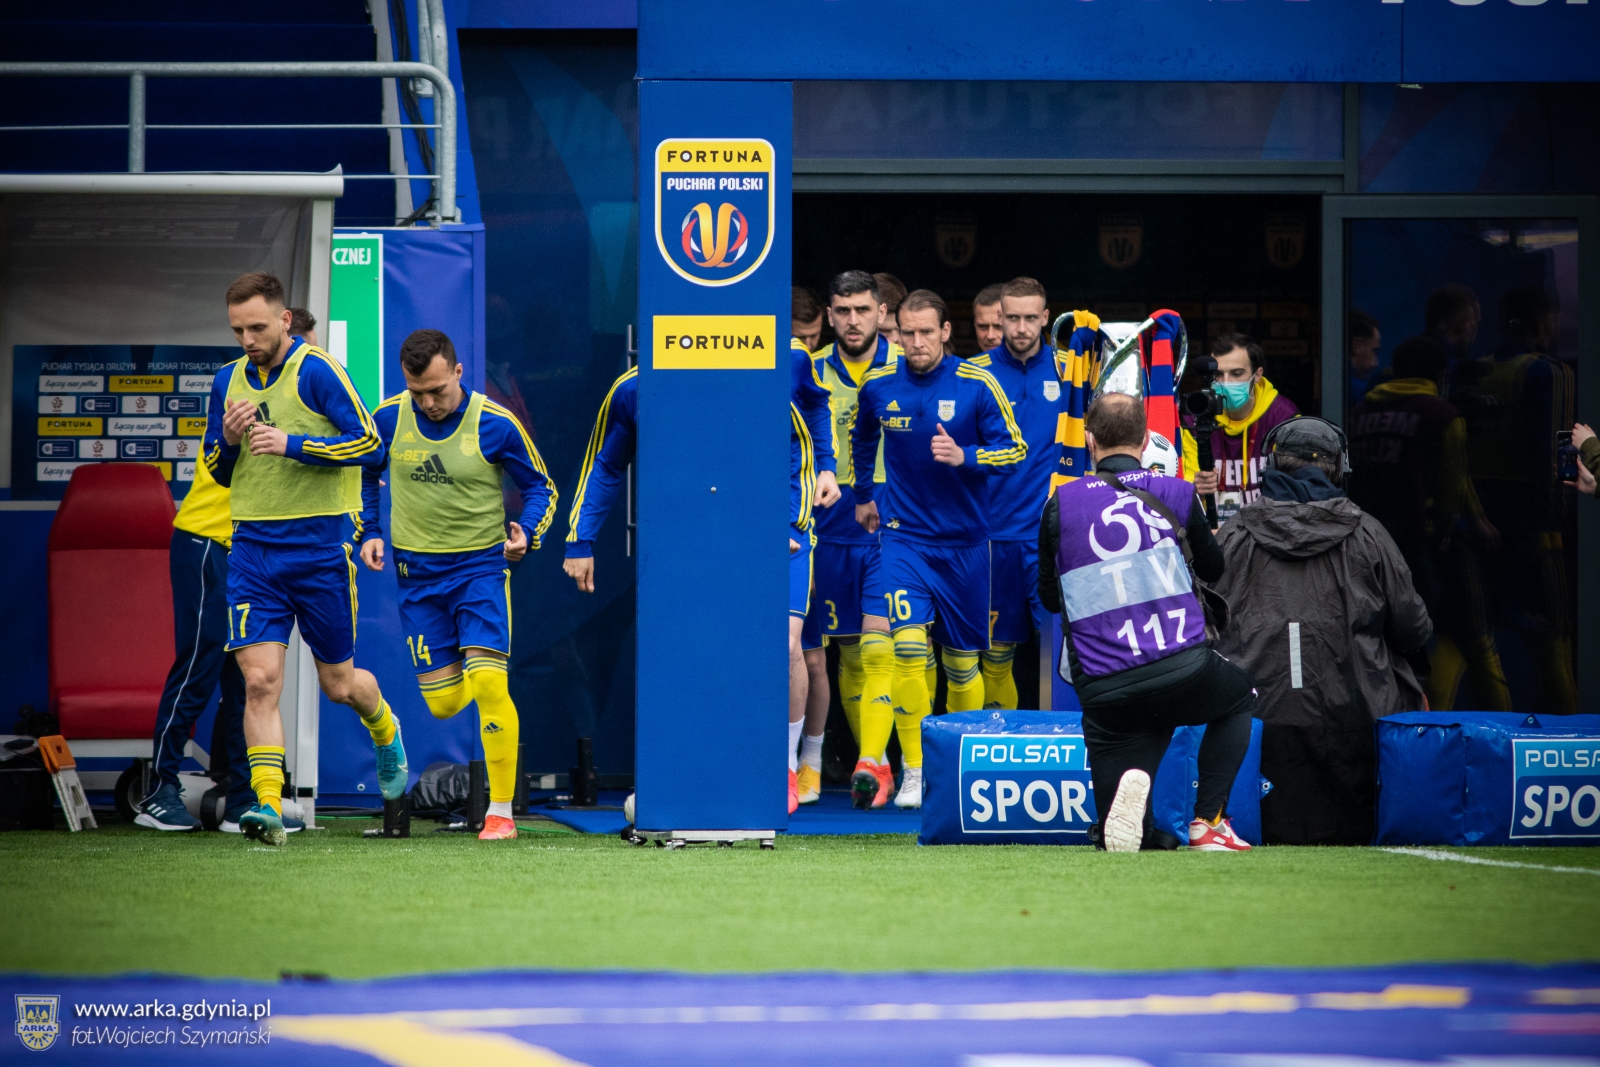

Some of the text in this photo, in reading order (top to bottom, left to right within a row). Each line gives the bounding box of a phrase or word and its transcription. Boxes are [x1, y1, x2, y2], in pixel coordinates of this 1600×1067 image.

[667, 150, 763, 163] FORTUNA
[667, 177, 763, 191] PUCHAR POLSKI
[331, 247, 372, 266] CZNEJ
[665, 335, 765, 350] FORTUNA
[41, 362, 72, 370] PUCHAR
[74, 362, 104, 372] TYSIĄCA
[147, 362, 178, 370] PUCHAR
[410, 472, 454, 485] adidas
[886, 518, 901, 529] 26
[399, 562, 409, 577] 14
[1101, 552, 1177, 605] TV
[884, 589, 912, 624] 26
[1116, 607, 1188, 657] 117
[407, 634, 432, 667] 14
[971, 744, 1076, 763] POLSAT
[970, 779, 1094, 823] SPOR
